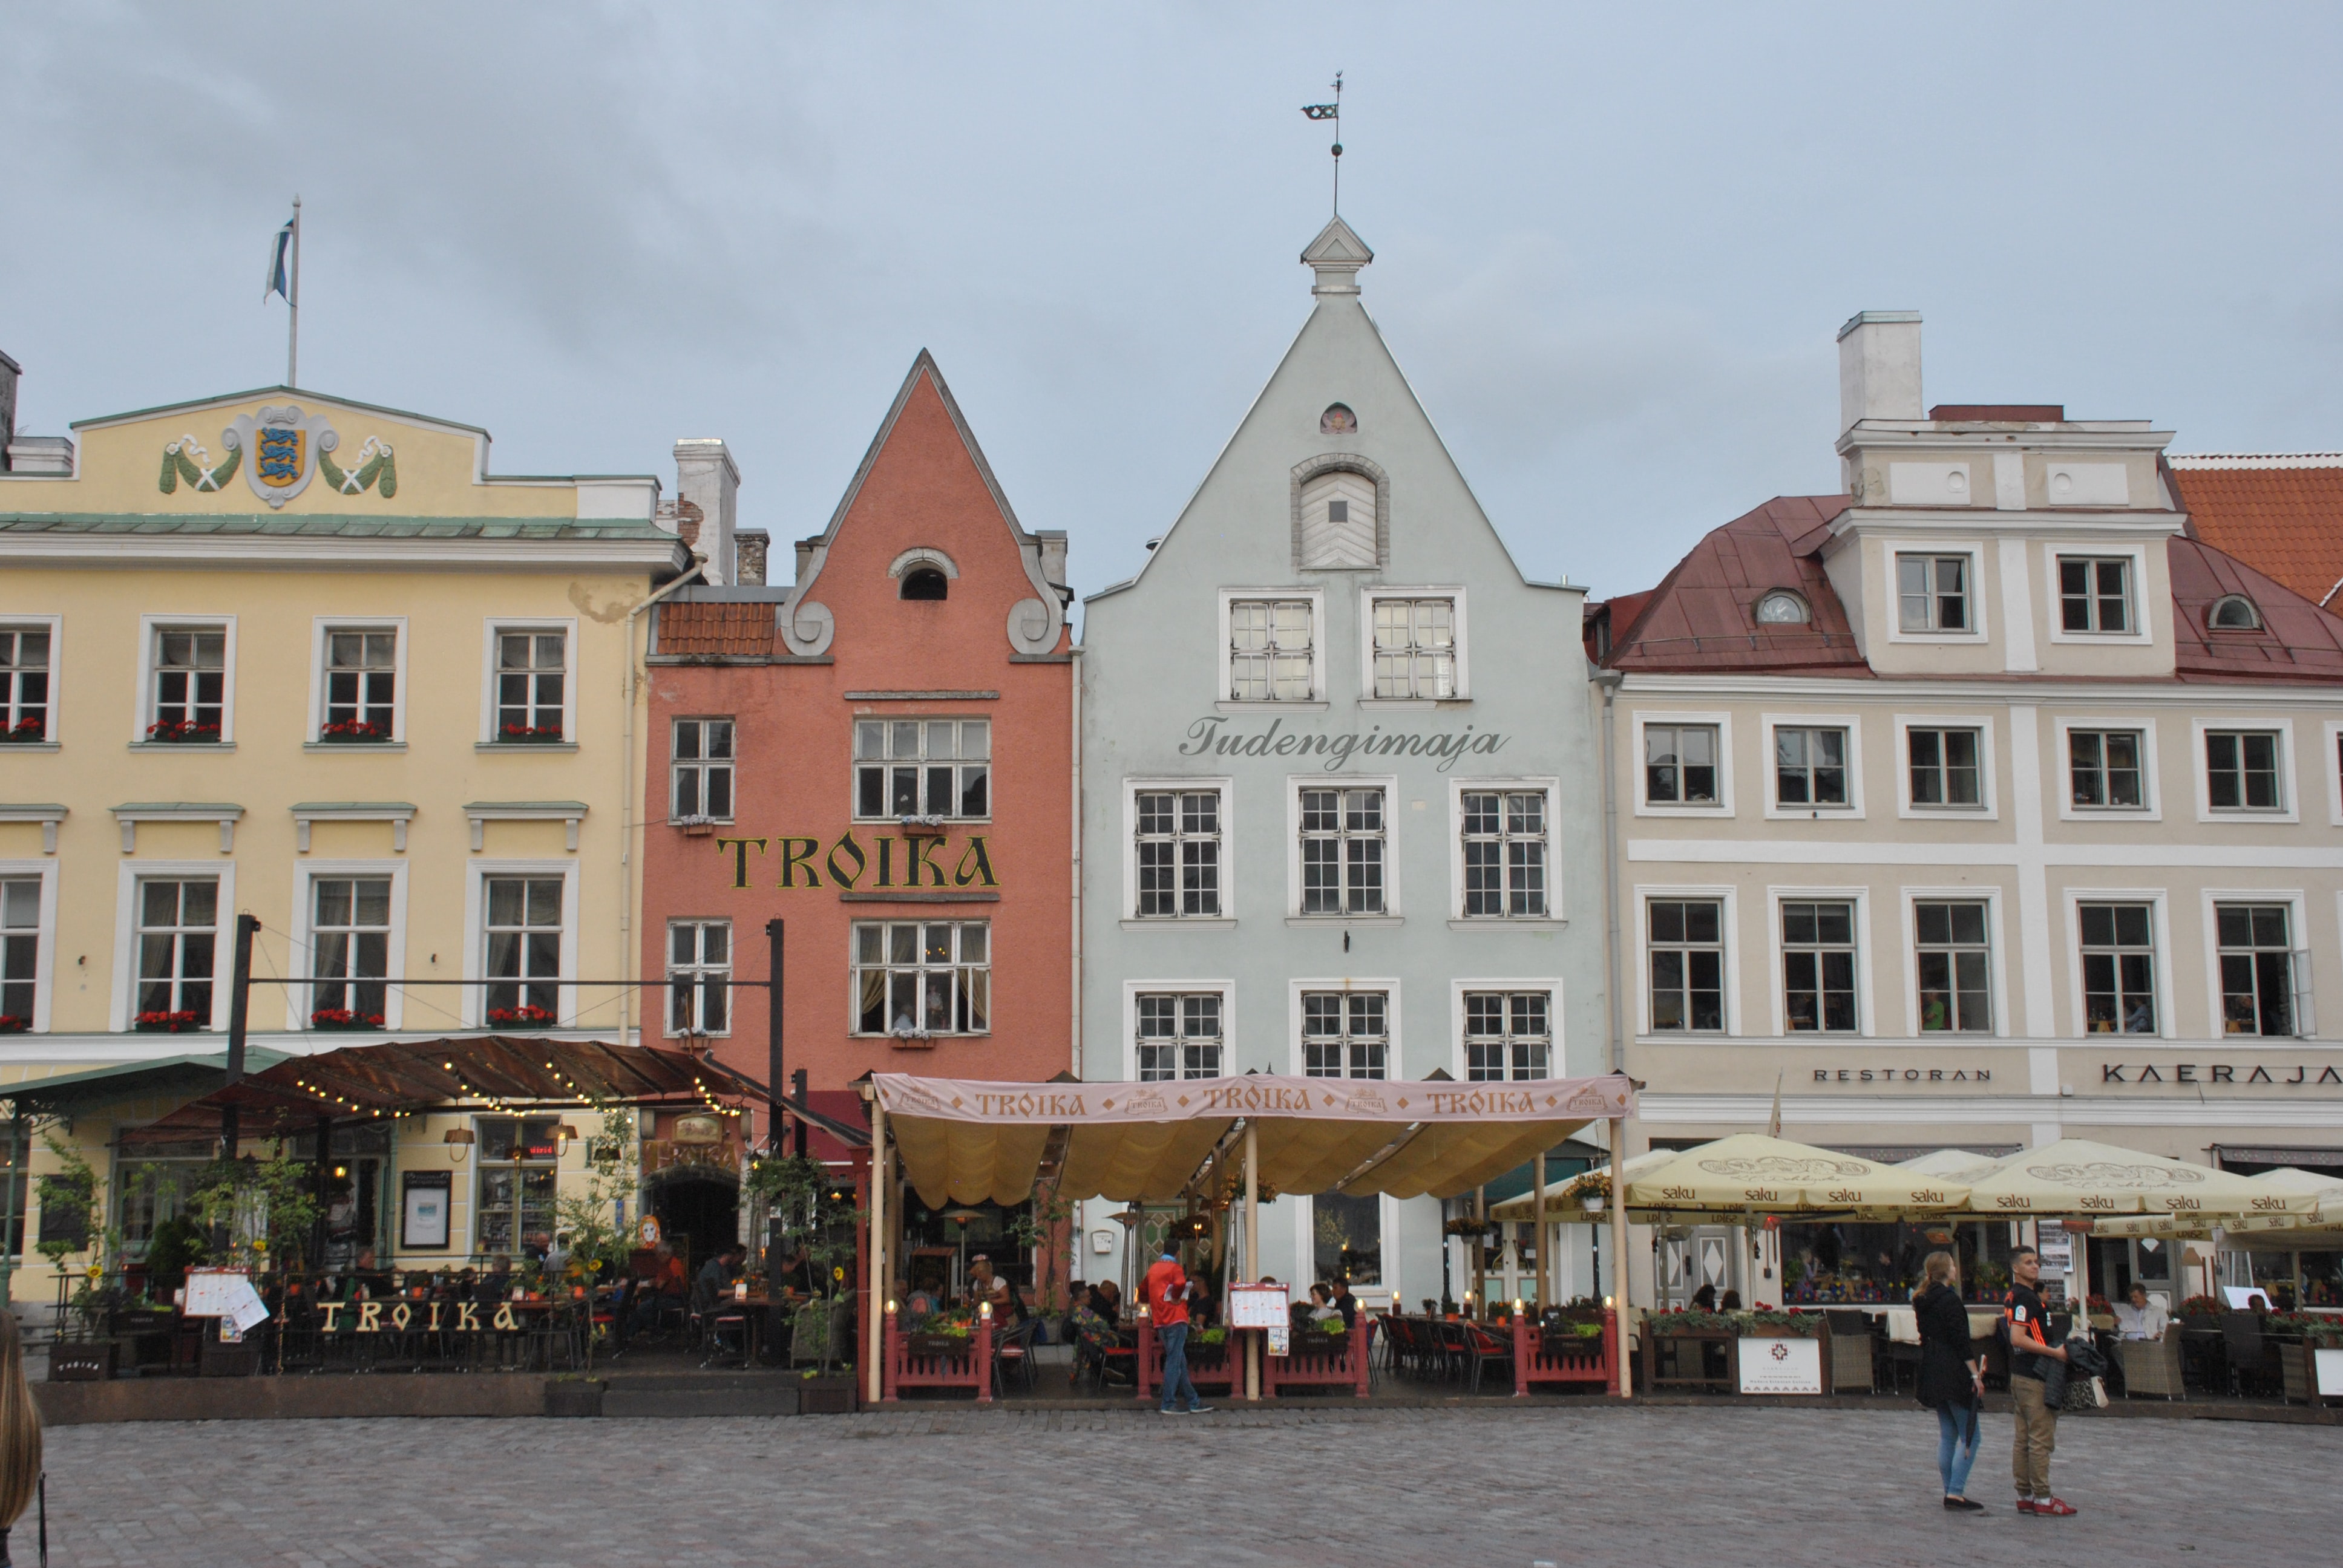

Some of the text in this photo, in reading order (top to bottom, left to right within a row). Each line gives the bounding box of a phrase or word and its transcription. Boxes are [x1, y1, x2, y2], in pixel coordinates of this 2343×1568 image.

[1179, 716, 1511, 773] Tudengimaja
[716, 828, 1001, 892] TROIKA
[1814, 1070, 1990, 1080] RESTORAN
[2103, 1064, 2342, 1083] KAERAJA
[905, 1096, 936, 1105] TROIKA
[975, 1092, 1087, 1117] TROIKA
[1204, 1084, 1312, 1111] TROIKA
[1426, 1089, 1536, 1116] TROIKA
[1663, 1186, 1696, 1200] saku
[1745, 1187, 1778, 1202] saku
[1829, 1189, 1861, 1203] saku
[1911, 1189, 1944, 1203] saku
[1997, 1195, 2030, 1209] saku
[2081, 1195, 2115, 1209] saku
[2166, 1195, 2201, 1209] saku
[2252, 1196, 2286, 1210] saku
[2158, 1218, 2172, 1230] saku
[2232, 1218, 2247, 1230] saku
[2269, 1216, 2284, 1227] saku
[2307, 1212, 2324, 1224] saku
[2126, 1221, 2140, 1232] saku
[316, 1302, 519, 1331] TROIKA
